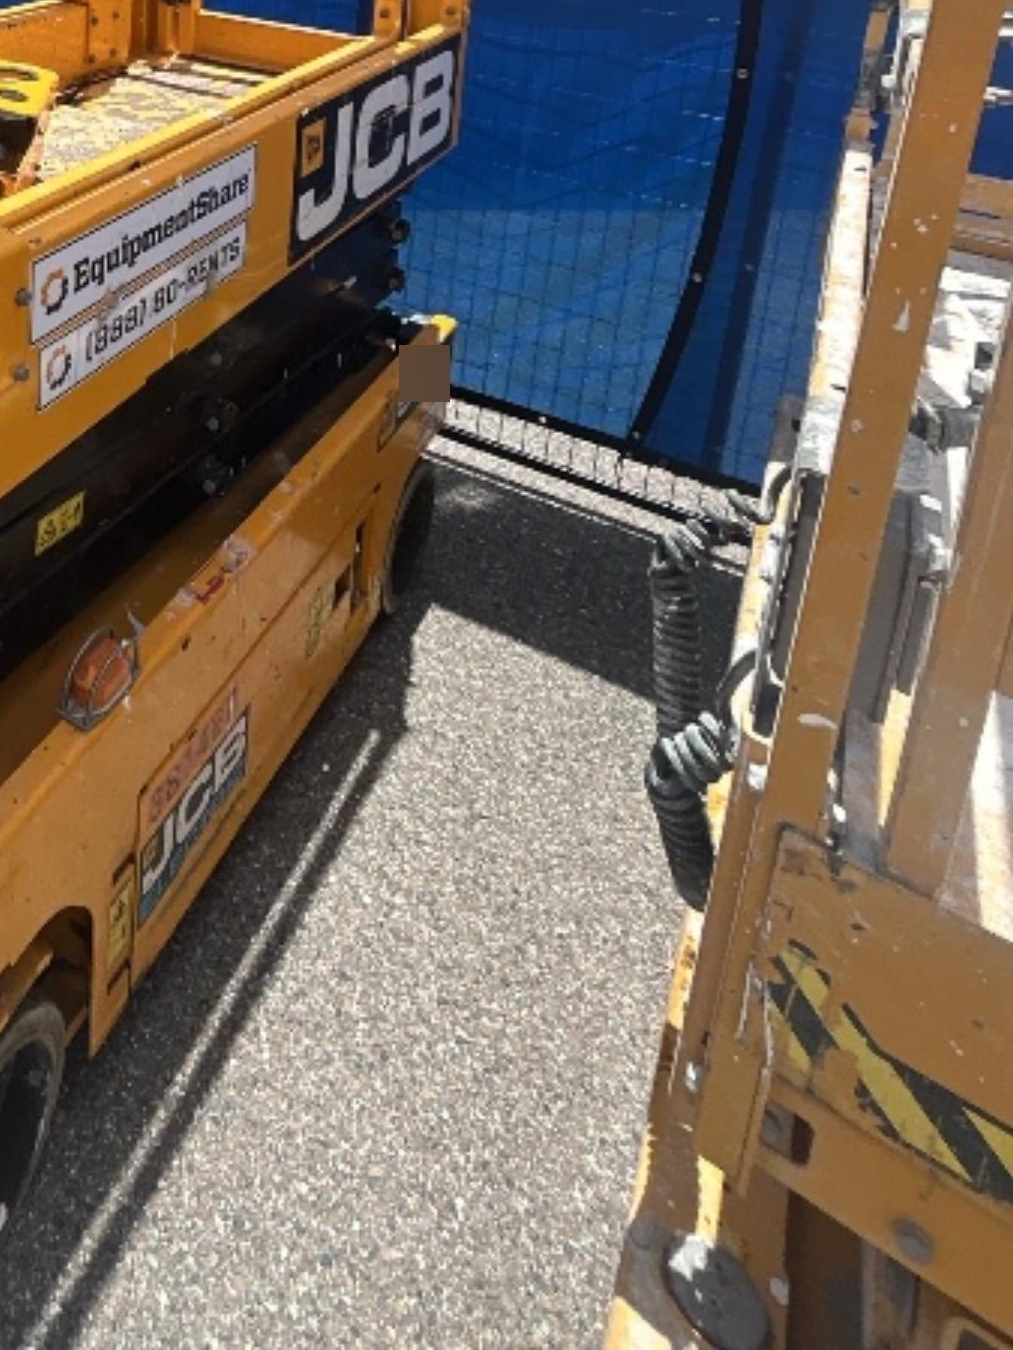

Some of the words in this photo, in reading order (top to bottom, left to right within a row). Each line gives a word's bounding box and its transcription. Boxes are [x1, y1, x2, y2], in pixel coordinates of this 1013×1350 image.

[73, 172, 249, 294] EquipmentShare
[296, 50, 454, 241] JCB
[142, 715, 247, 895] JCB
